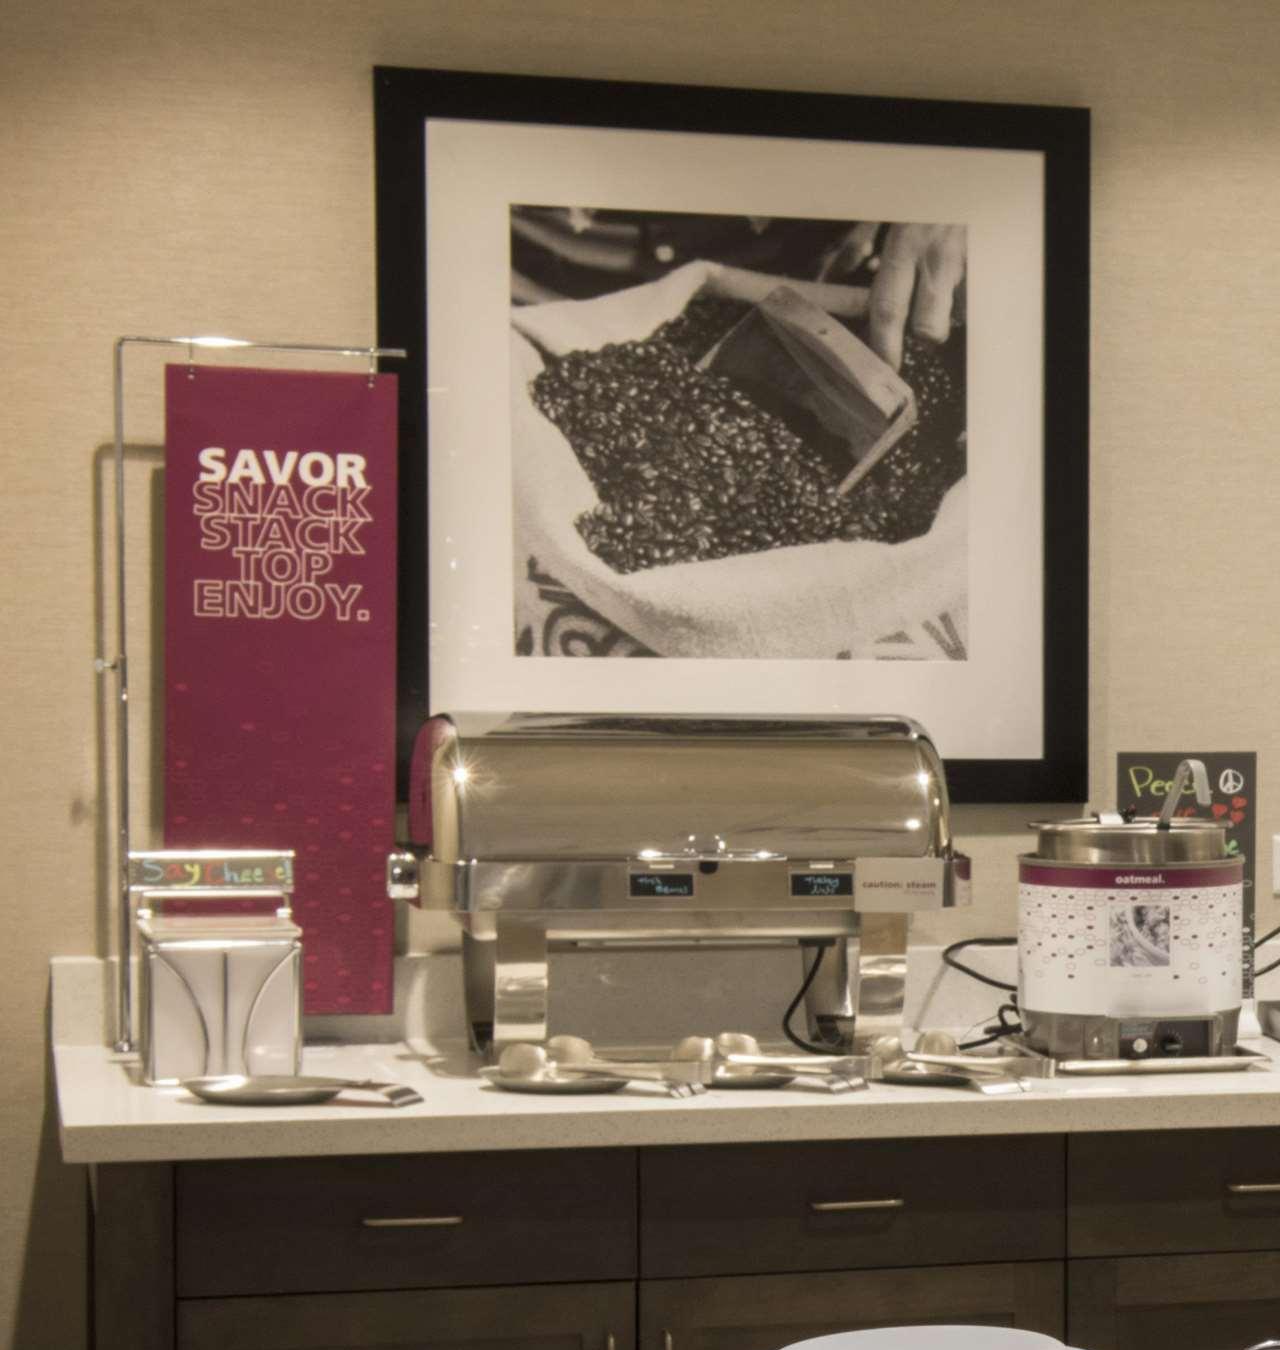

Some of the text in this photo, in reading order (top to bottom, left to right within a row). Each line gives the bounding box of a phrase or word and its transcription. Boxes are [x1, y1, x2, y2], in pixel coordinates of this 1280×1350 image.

[198, 446, 367, 488] SAVOR
[193, 479, 373, 521] SNACK
[200, 513, 366, 555] STACK
[232, 547, 332, 585] TOP
[193, 579, 370, 621] ENJOY.
[142, 858, 201, 887] Say
[906, 880, 937, 889] steam
[1115, 874, 1166, 885] oatmeal.
